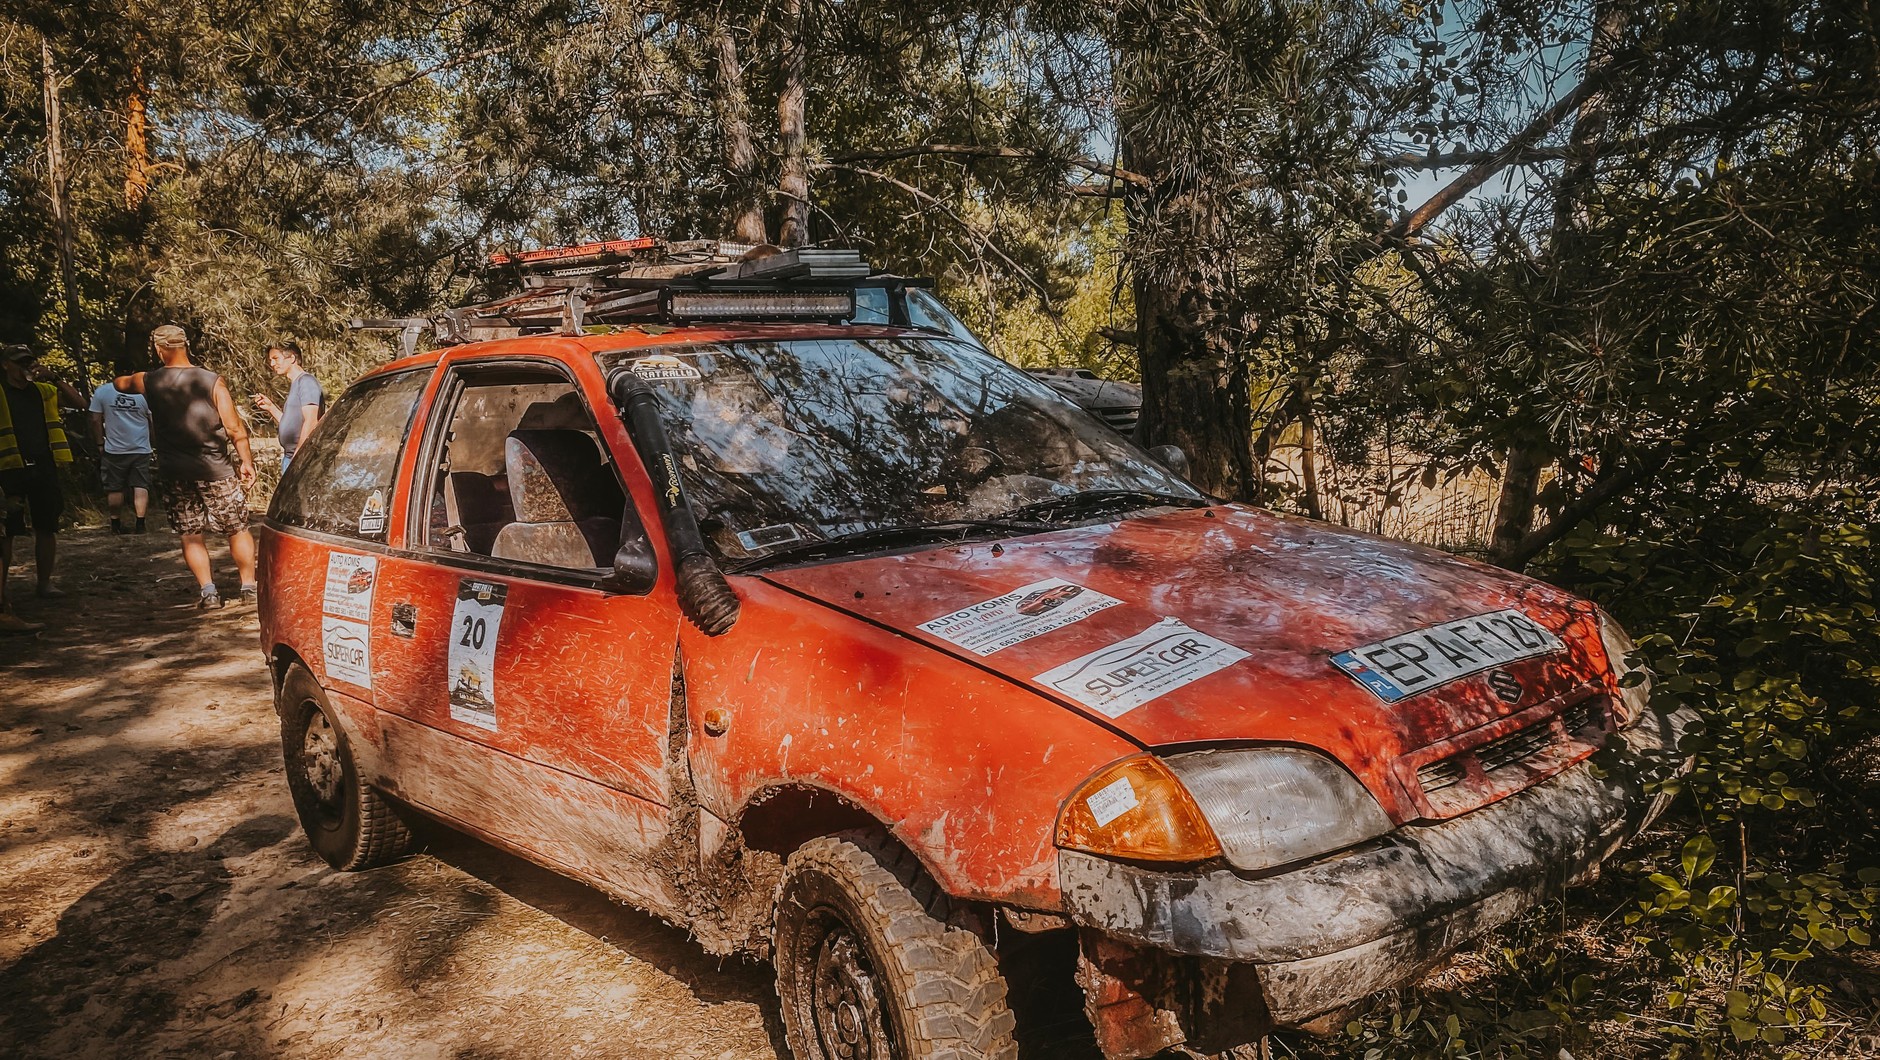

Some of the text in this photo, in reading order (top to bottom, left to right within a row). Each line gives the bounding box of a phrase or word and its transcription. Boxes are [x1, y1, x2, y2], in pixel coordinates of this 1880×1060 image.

[926, 611, 971, 630] AUTO
[970, 593, 1022, 613] KOMIS
[459, 615, 486, 650] 20
[981, 646, 1000, 655] tel.
[999, 637, 1019, 647] 663
[1019, 630, 1039, 640] 082
[1038, 623, 1058, 633] 581
[1370, 680, 1393, 692] PL
